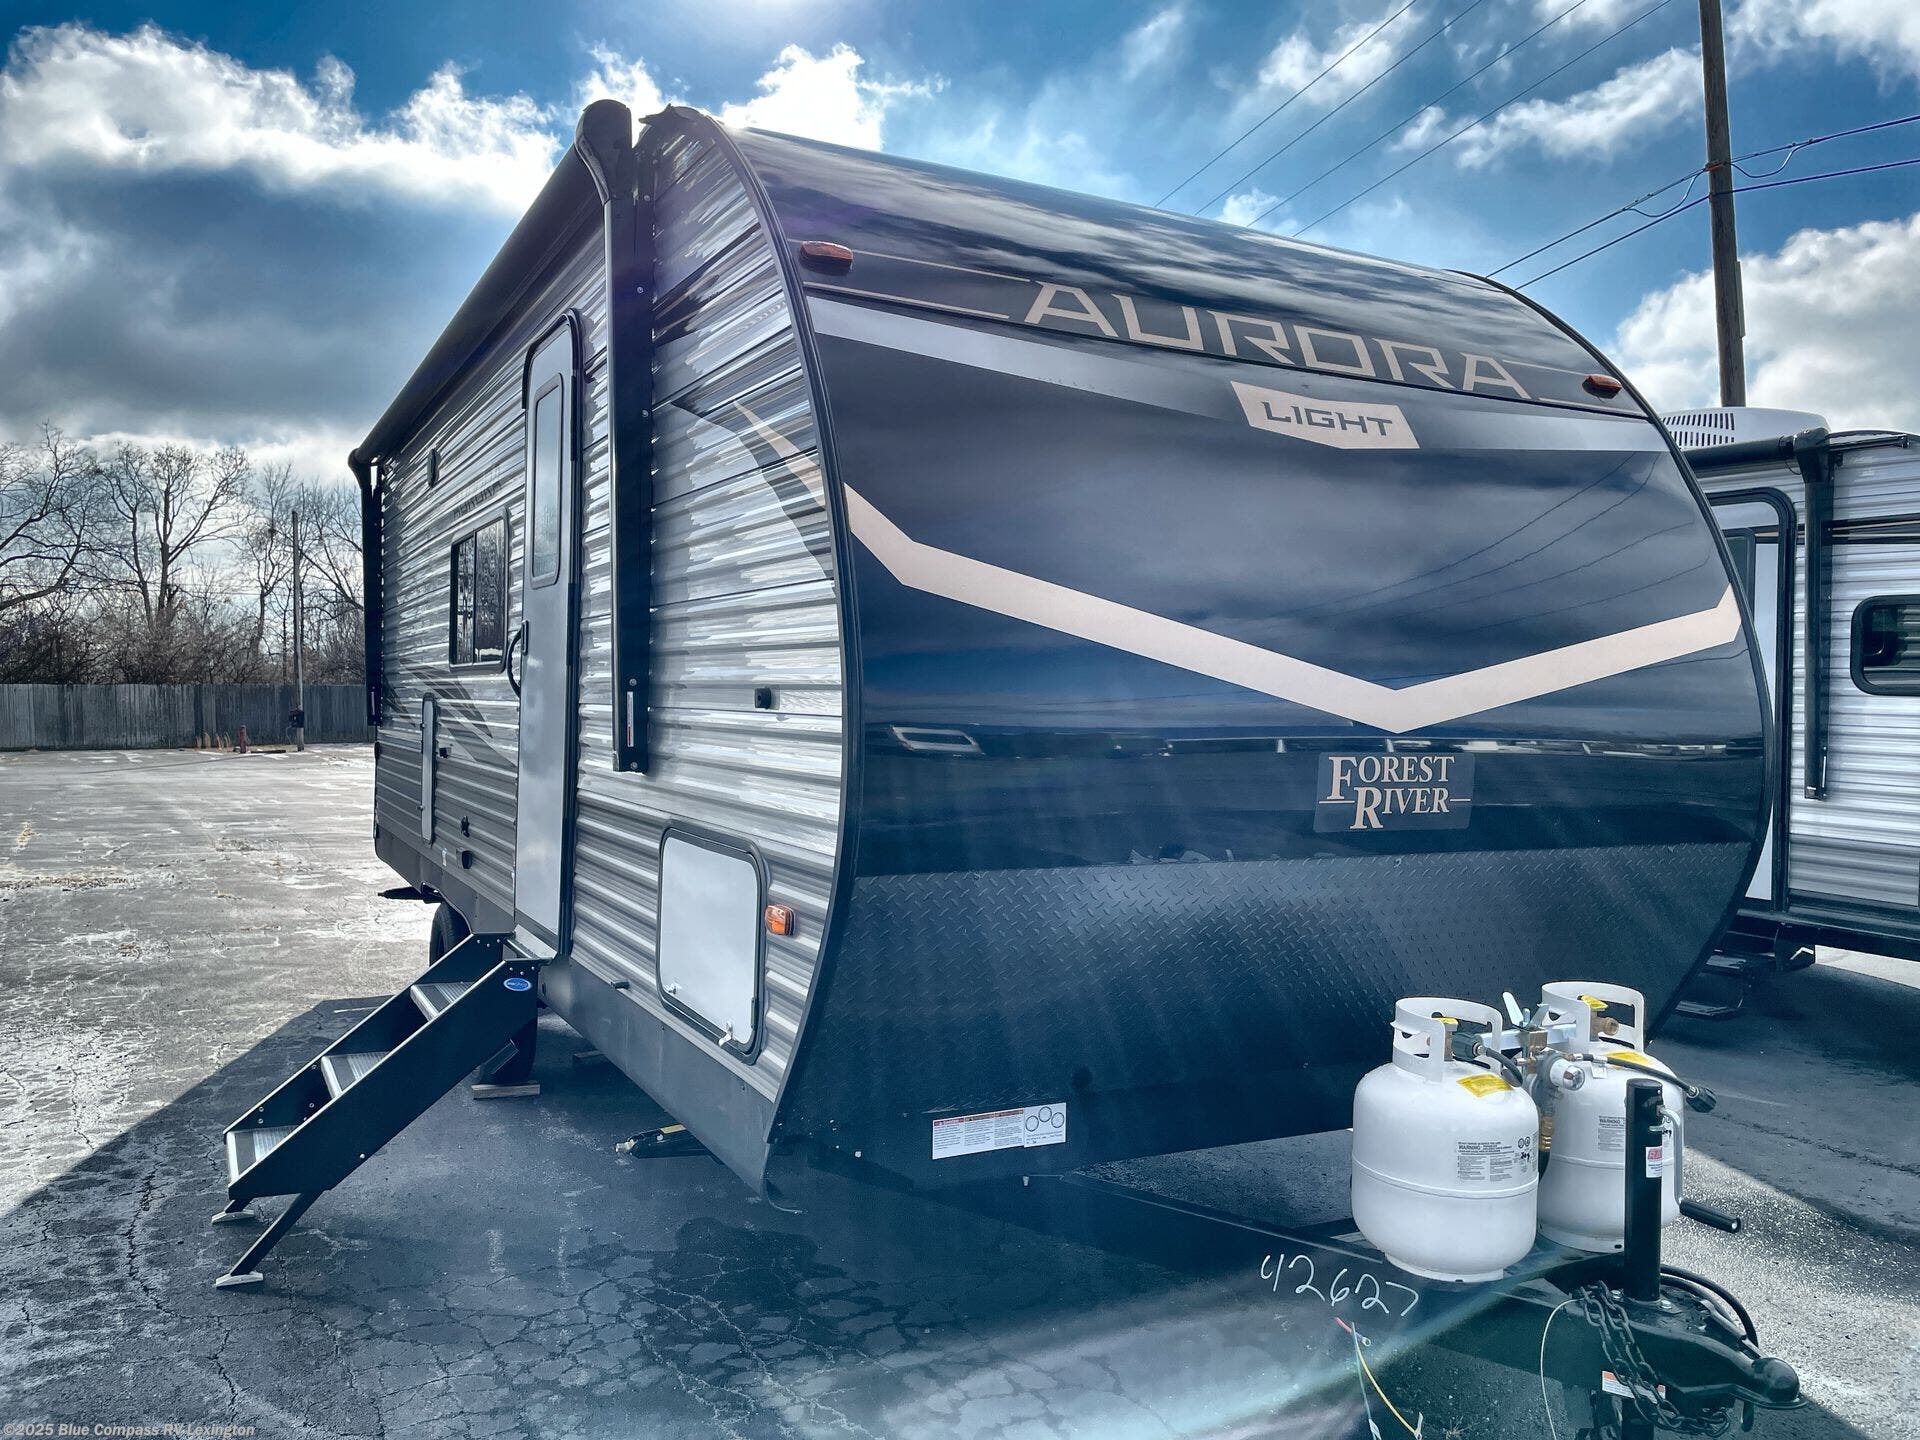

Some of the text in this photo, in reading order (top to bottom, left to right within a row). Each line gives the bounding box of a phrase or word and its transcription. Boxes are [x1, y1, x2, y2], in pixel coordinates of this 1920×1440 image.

[1023, 280, 1532, 399] AURORA
[1261, 401, 1393, 436] LIGHT
[1326, 756, 1456, 800] FOREST
[1350, 786, 1450, 829] RIVER
[1260, 1253, 1419, 1317] 42627
